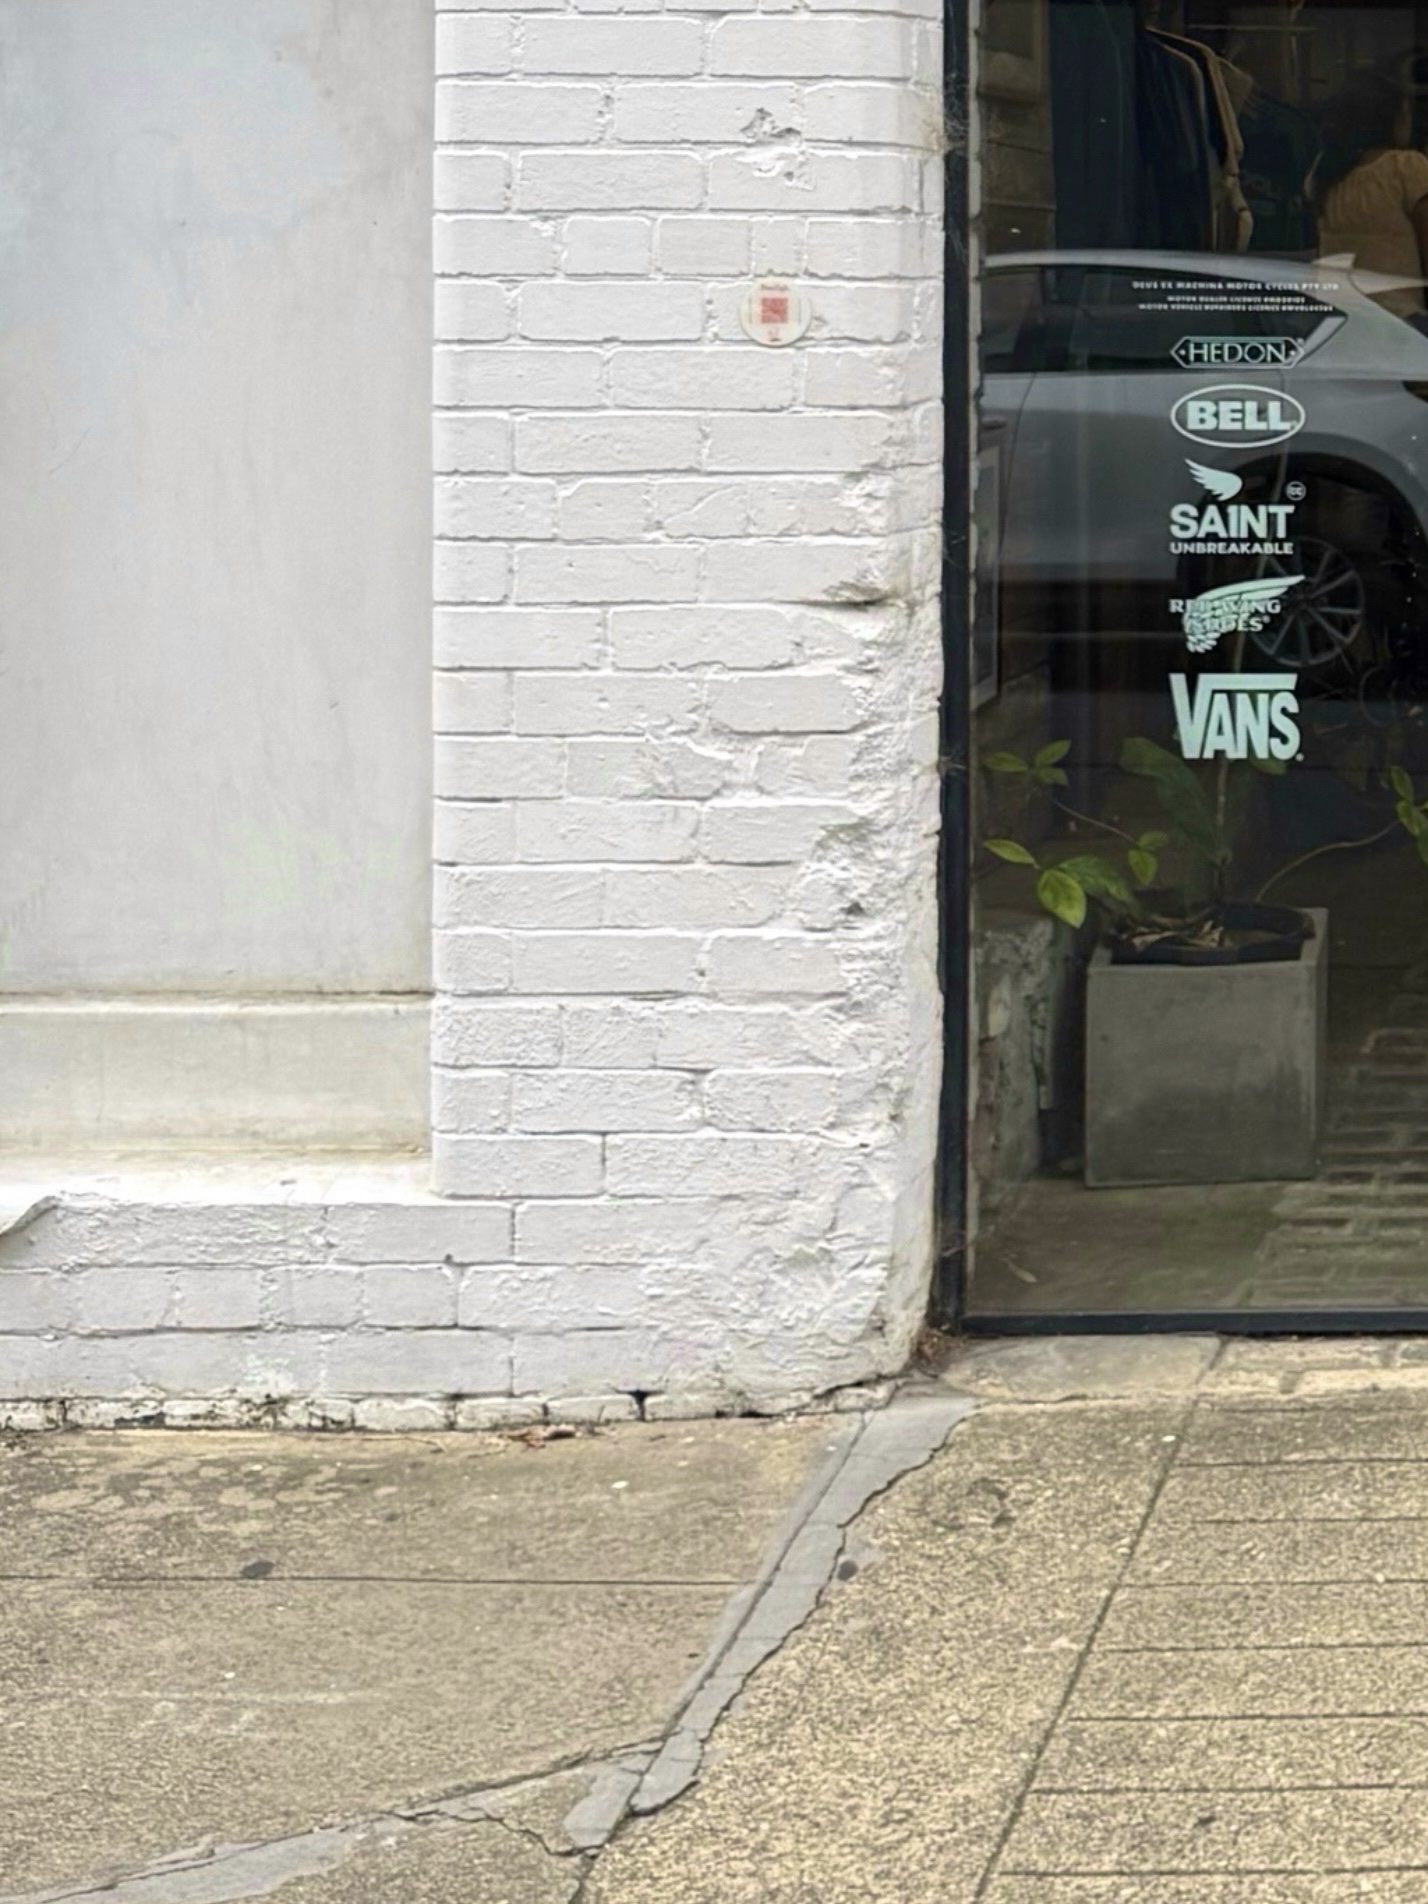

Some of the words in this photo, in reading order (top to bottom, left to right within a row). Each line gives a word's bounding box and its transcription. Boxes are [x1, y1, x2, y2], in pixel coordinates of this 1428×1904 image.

[1188, 342, 1286, 363] HEDON
[1186, 400, 1291, 431] BELL
[1169, 542, 1294, 554] UNBREAKABLE
[1169, 673, 1300, 760] VANS
